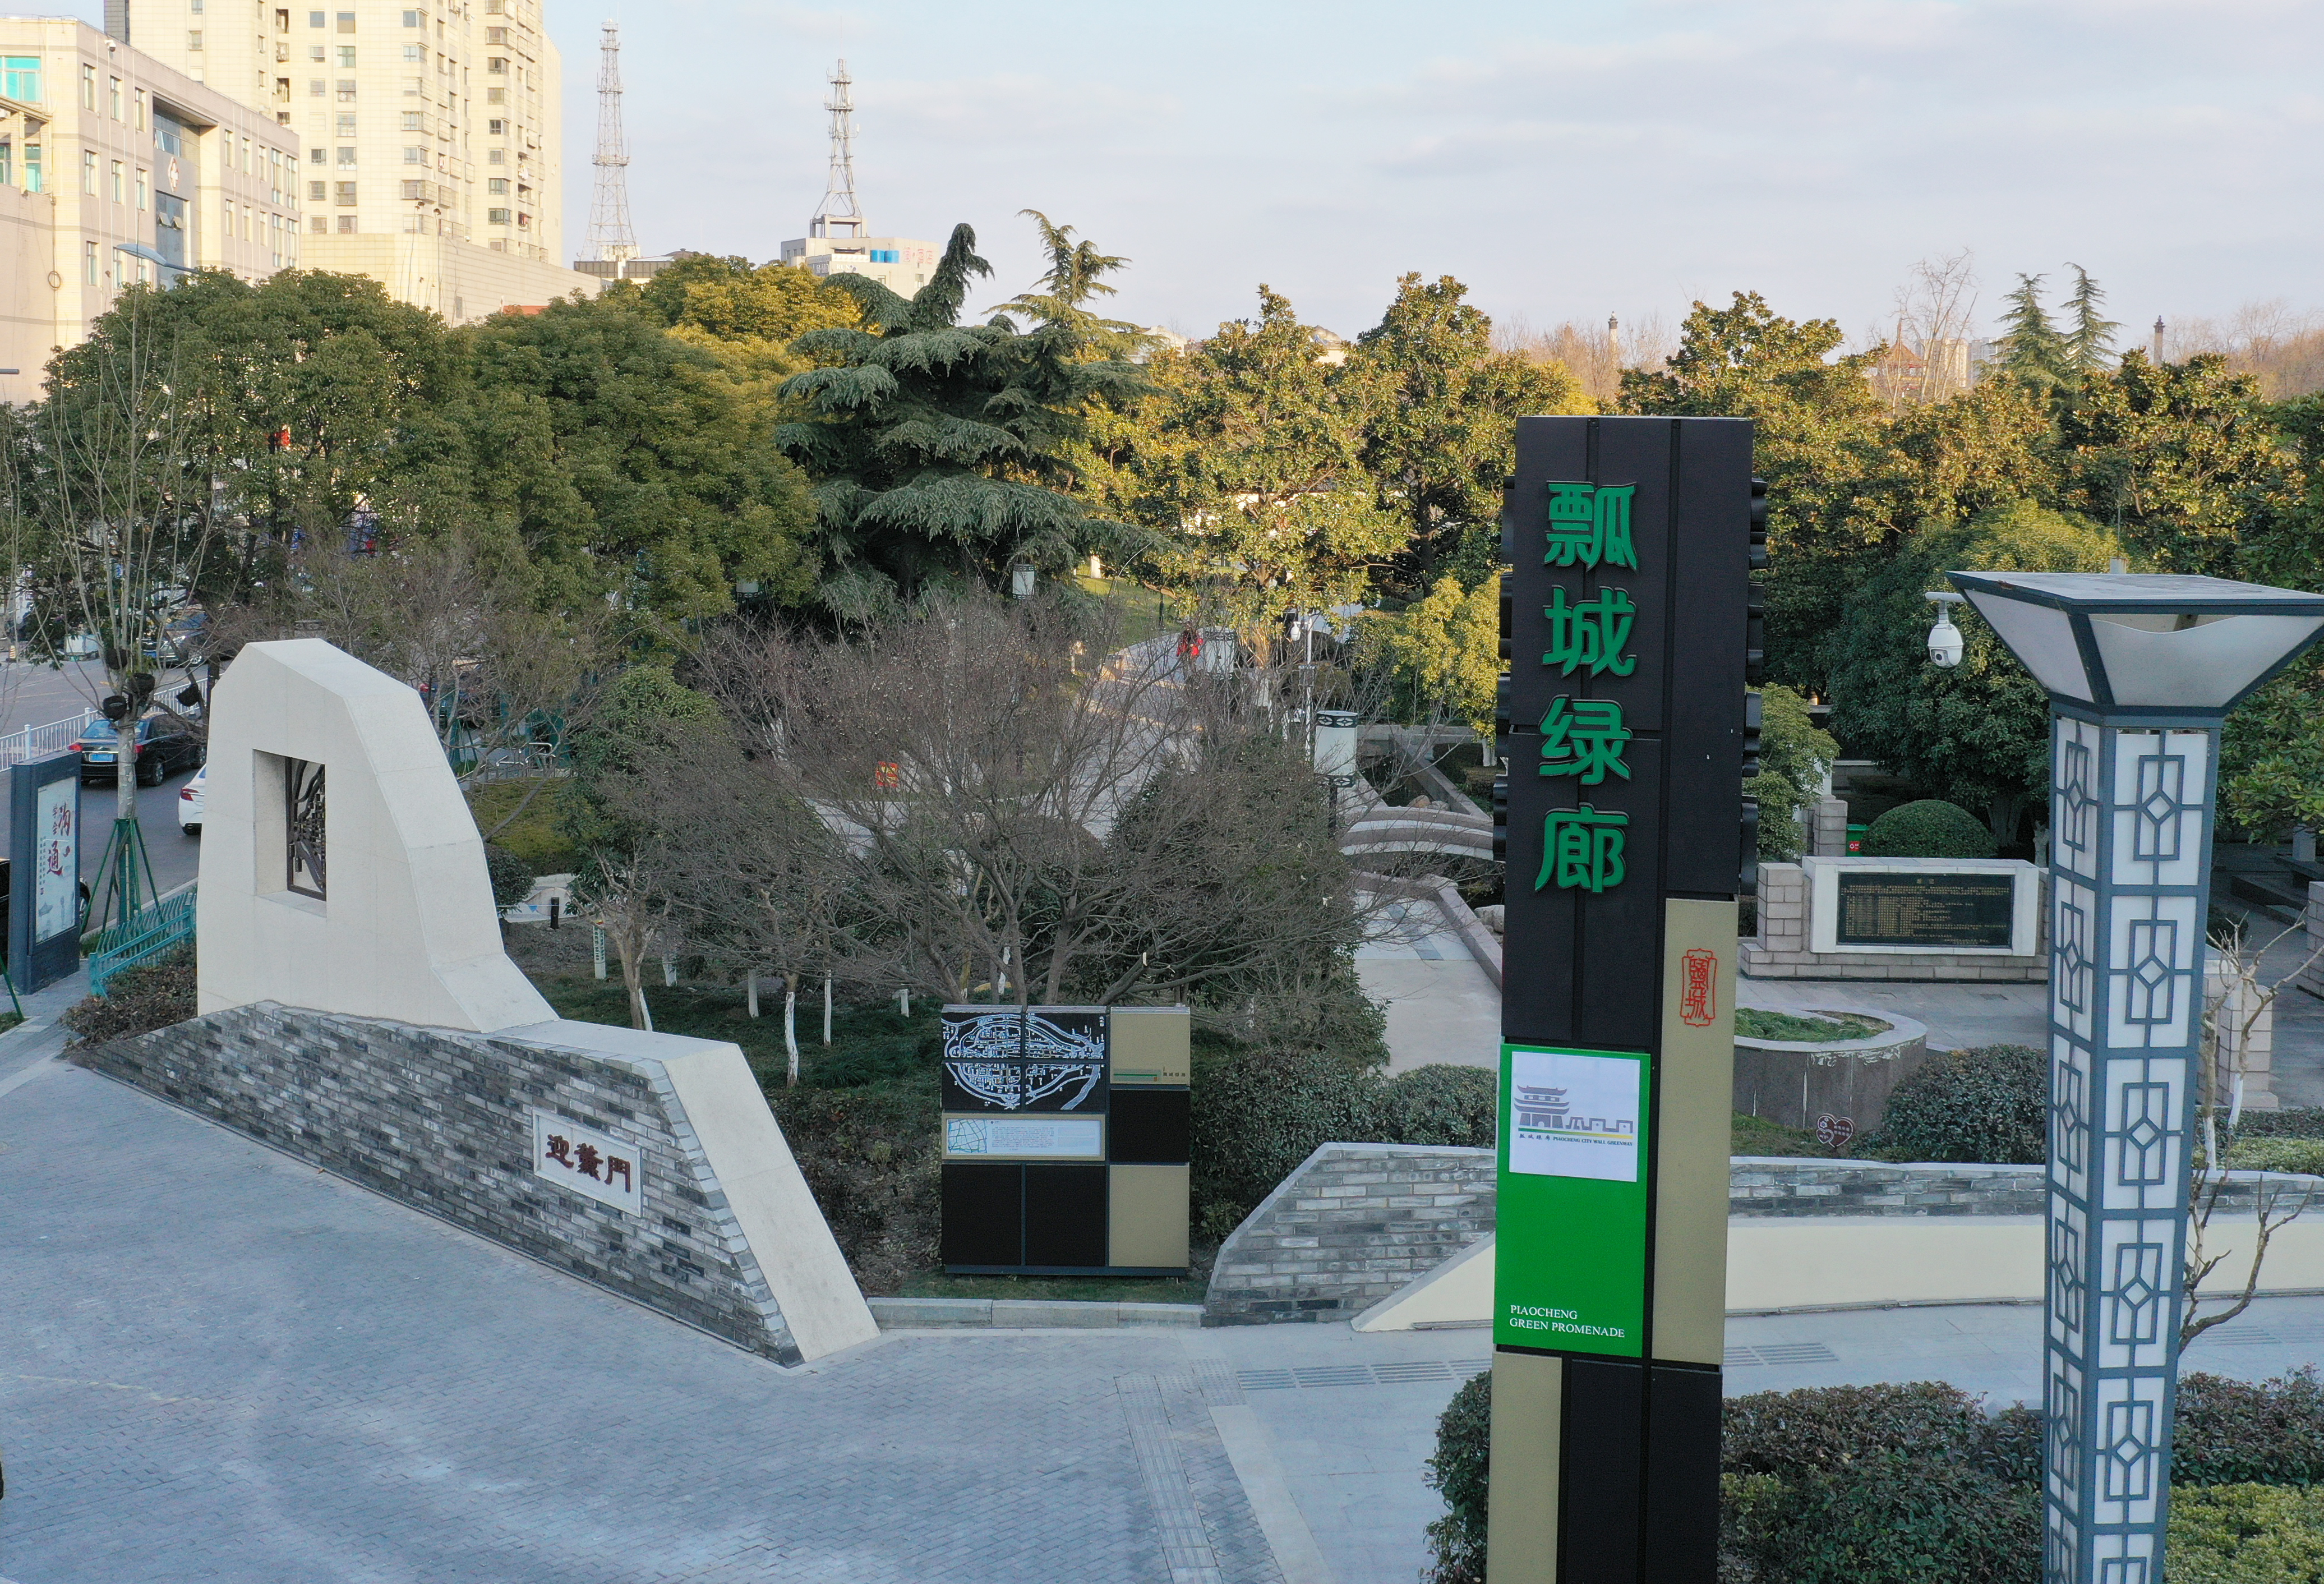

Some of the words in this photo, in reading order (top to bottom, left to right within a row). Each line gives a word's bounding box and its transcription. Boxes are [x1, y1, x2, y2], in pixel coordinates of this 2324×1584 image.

[1534, 480, 1638, 894] 瓢城绿廊
[1510, 1304, 1578, 1320] PIAOCHENG
[1509, 1318, 1549, 1330] GREEN
[1551, 1321, 1626, 1338] PROMENADE
